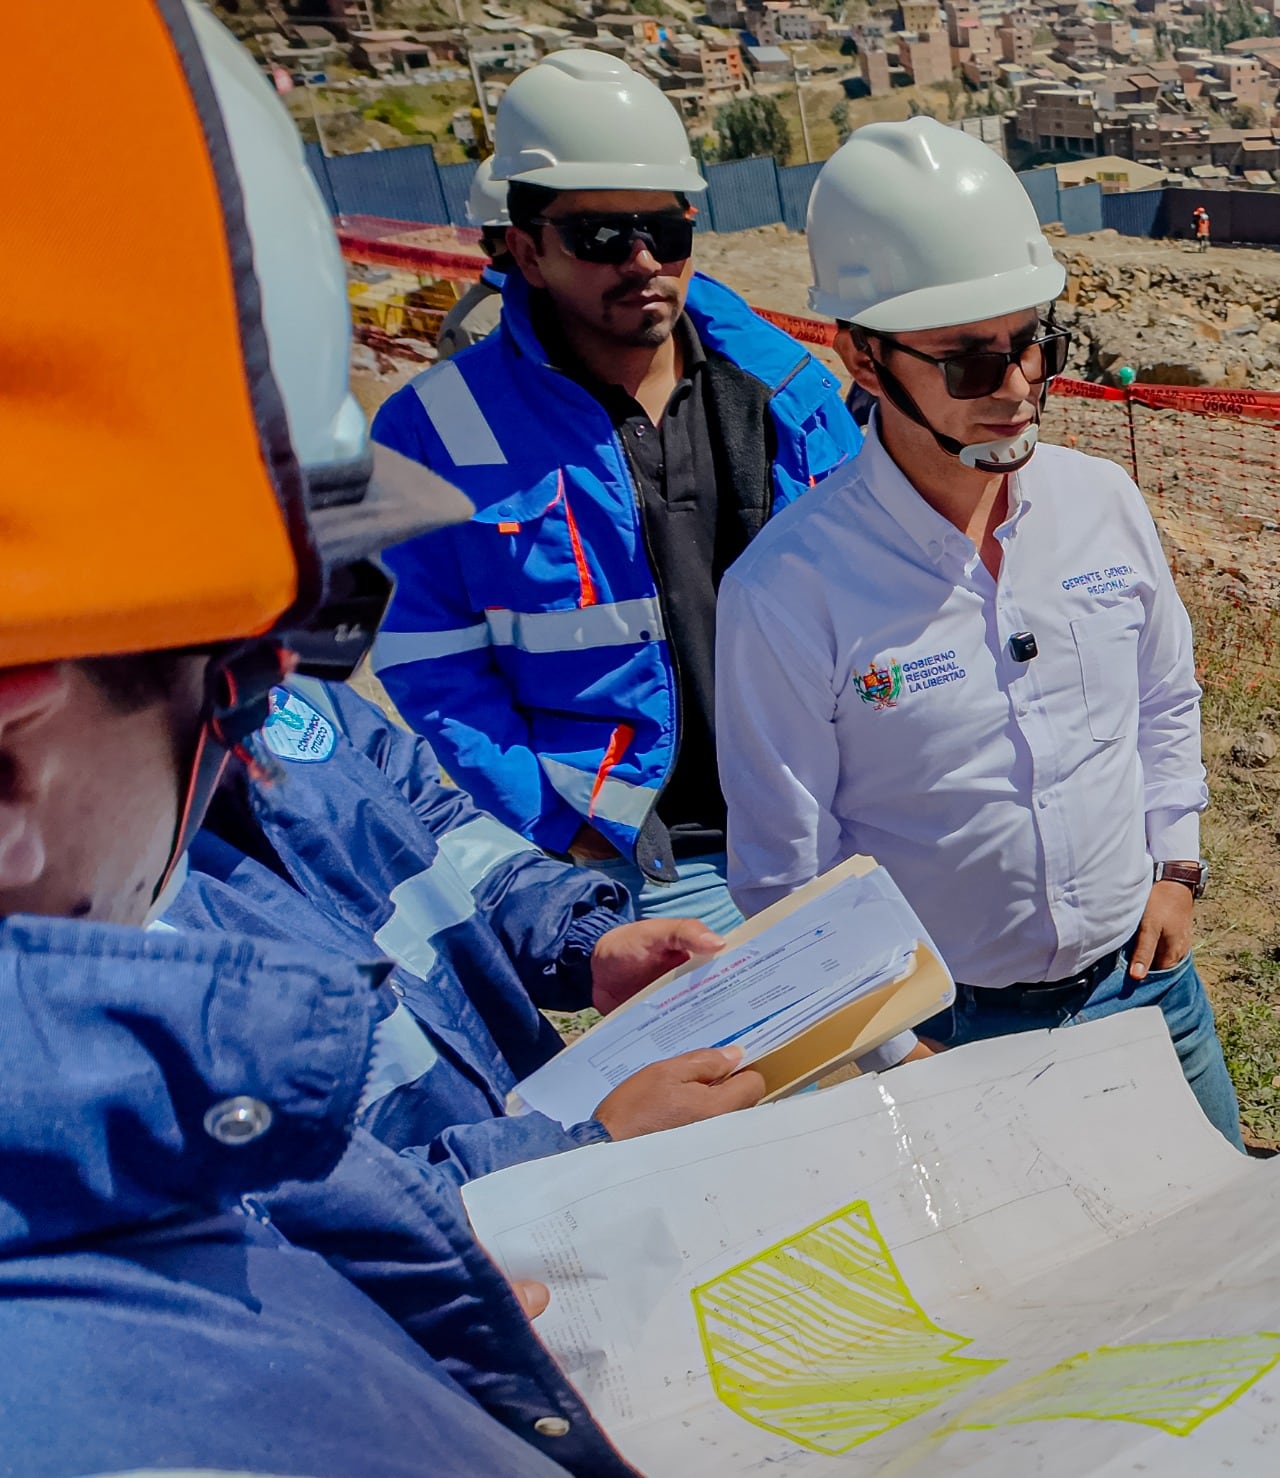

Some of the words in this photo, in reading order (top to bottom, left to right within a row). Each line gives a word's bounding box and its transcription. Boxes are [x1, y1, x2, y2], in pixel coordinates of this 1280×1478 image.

[1061, 571, 1102, 591] GERENTE
[1087, 579, 1129, 596] REGIONAL
[902, 650, 956, 672] GOBIERNO
[905, 662, 959, 683] REGIONAL
[923, 669, 966, 689] LIBERTAD
